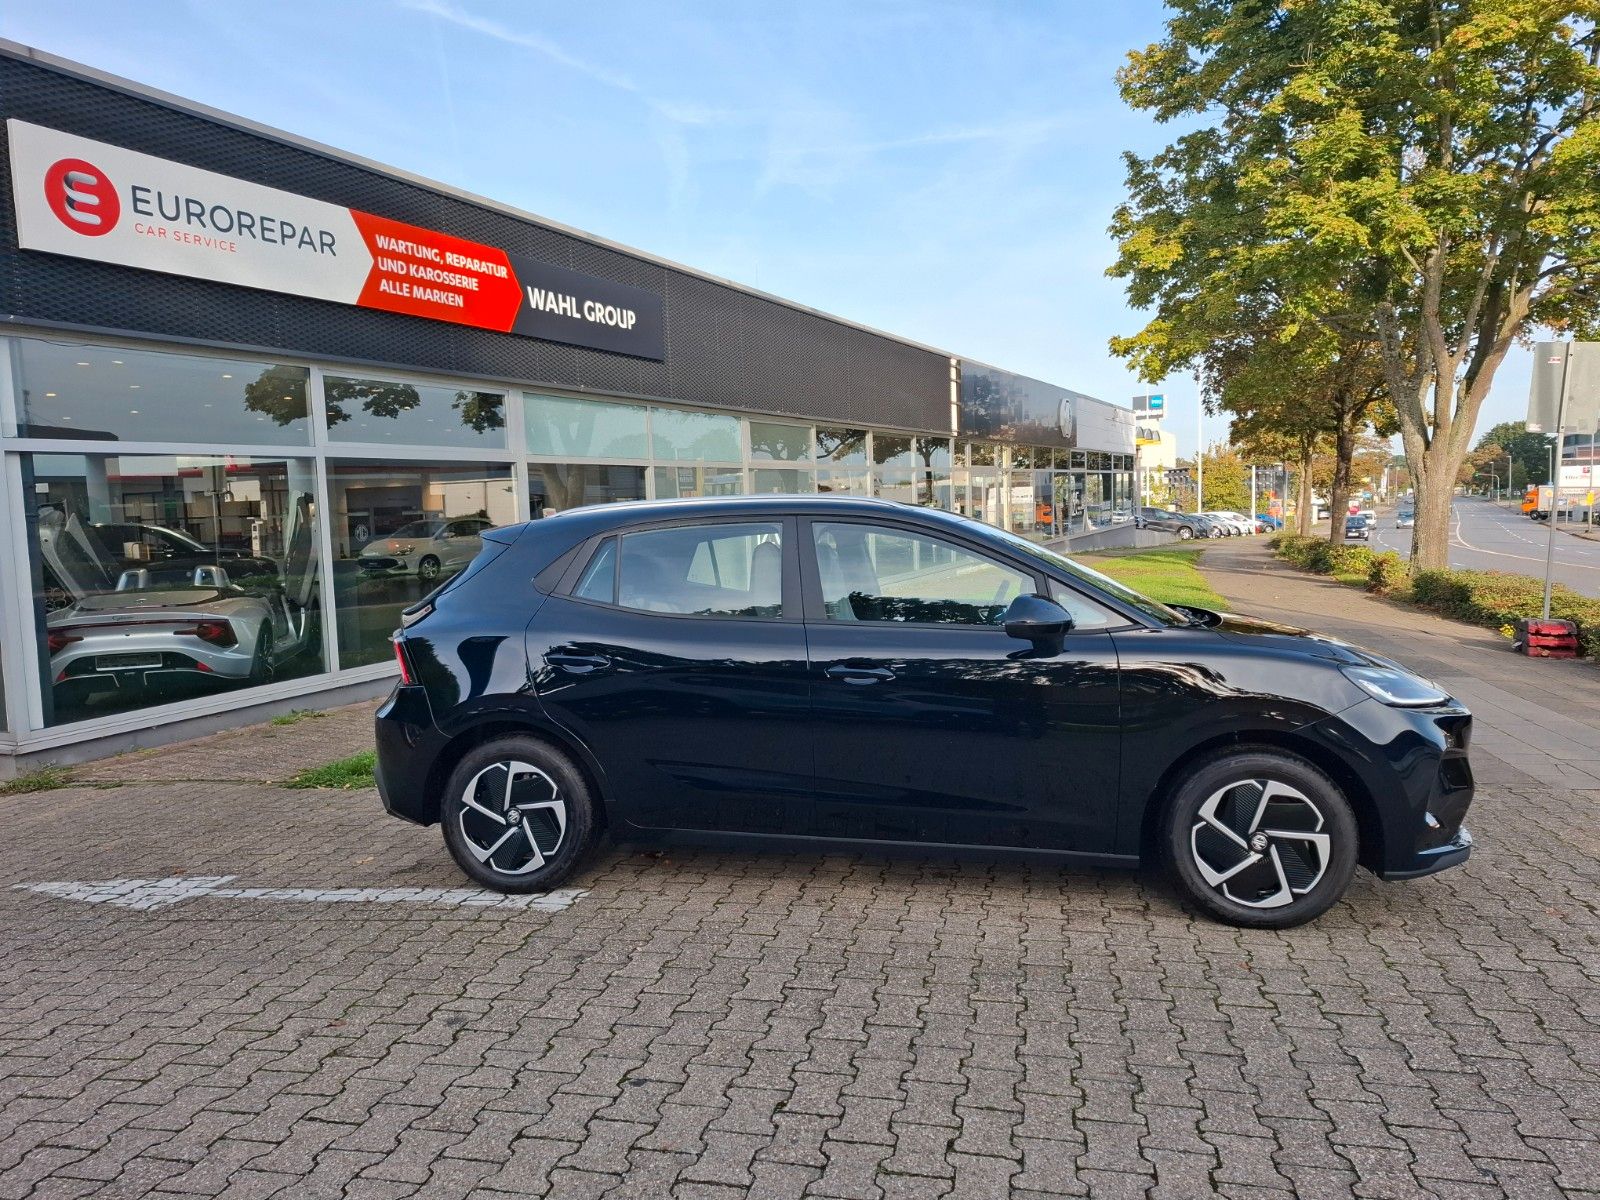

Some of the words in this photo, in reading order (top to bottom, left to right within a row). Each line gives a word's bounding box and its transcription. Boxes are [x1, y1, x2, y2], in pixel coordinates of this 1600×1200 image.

[131, 184, 337, 257] EUROREPAR
[135, 223, 167, 239] CAR
[173, 231, 237, 253] SERVICE
[375, 234, 444, 265] WARTUNG,
[445, 252, 509, 279] REPARATUR
[378, 256, 407, 275] UND
[409, 264, 479, 291] KAROSSERIE
[379, 279, 411, 298] ALLE
[412, 286, 464, 308] MARKEN
[527, 286, 581, 319] WAHL
[583, 300, 636, 330] GROUP
